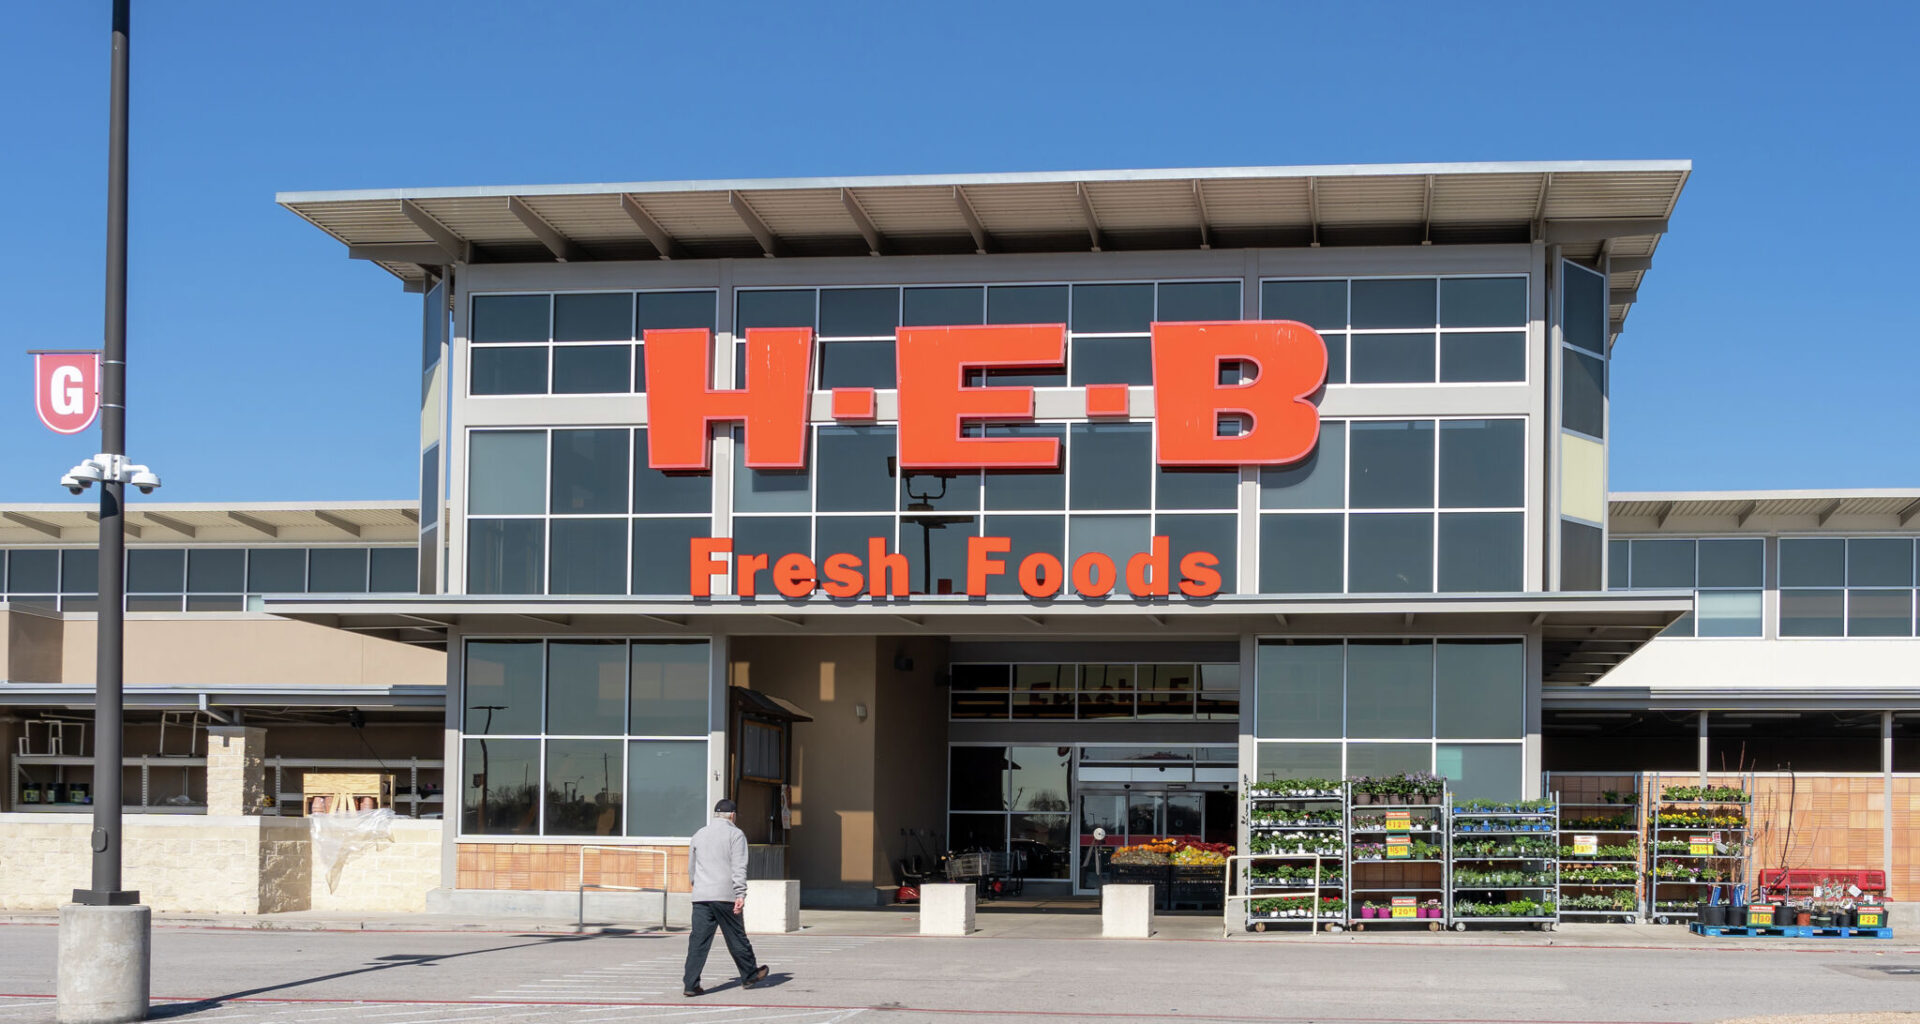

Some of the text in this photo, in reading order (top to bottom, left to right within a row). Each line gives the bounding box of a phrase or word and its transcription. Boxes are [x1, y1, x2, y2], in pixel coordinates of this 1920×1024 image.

[51, 365, 84, 415] G
[690, 535, 1222, 598] Fresh Foods
